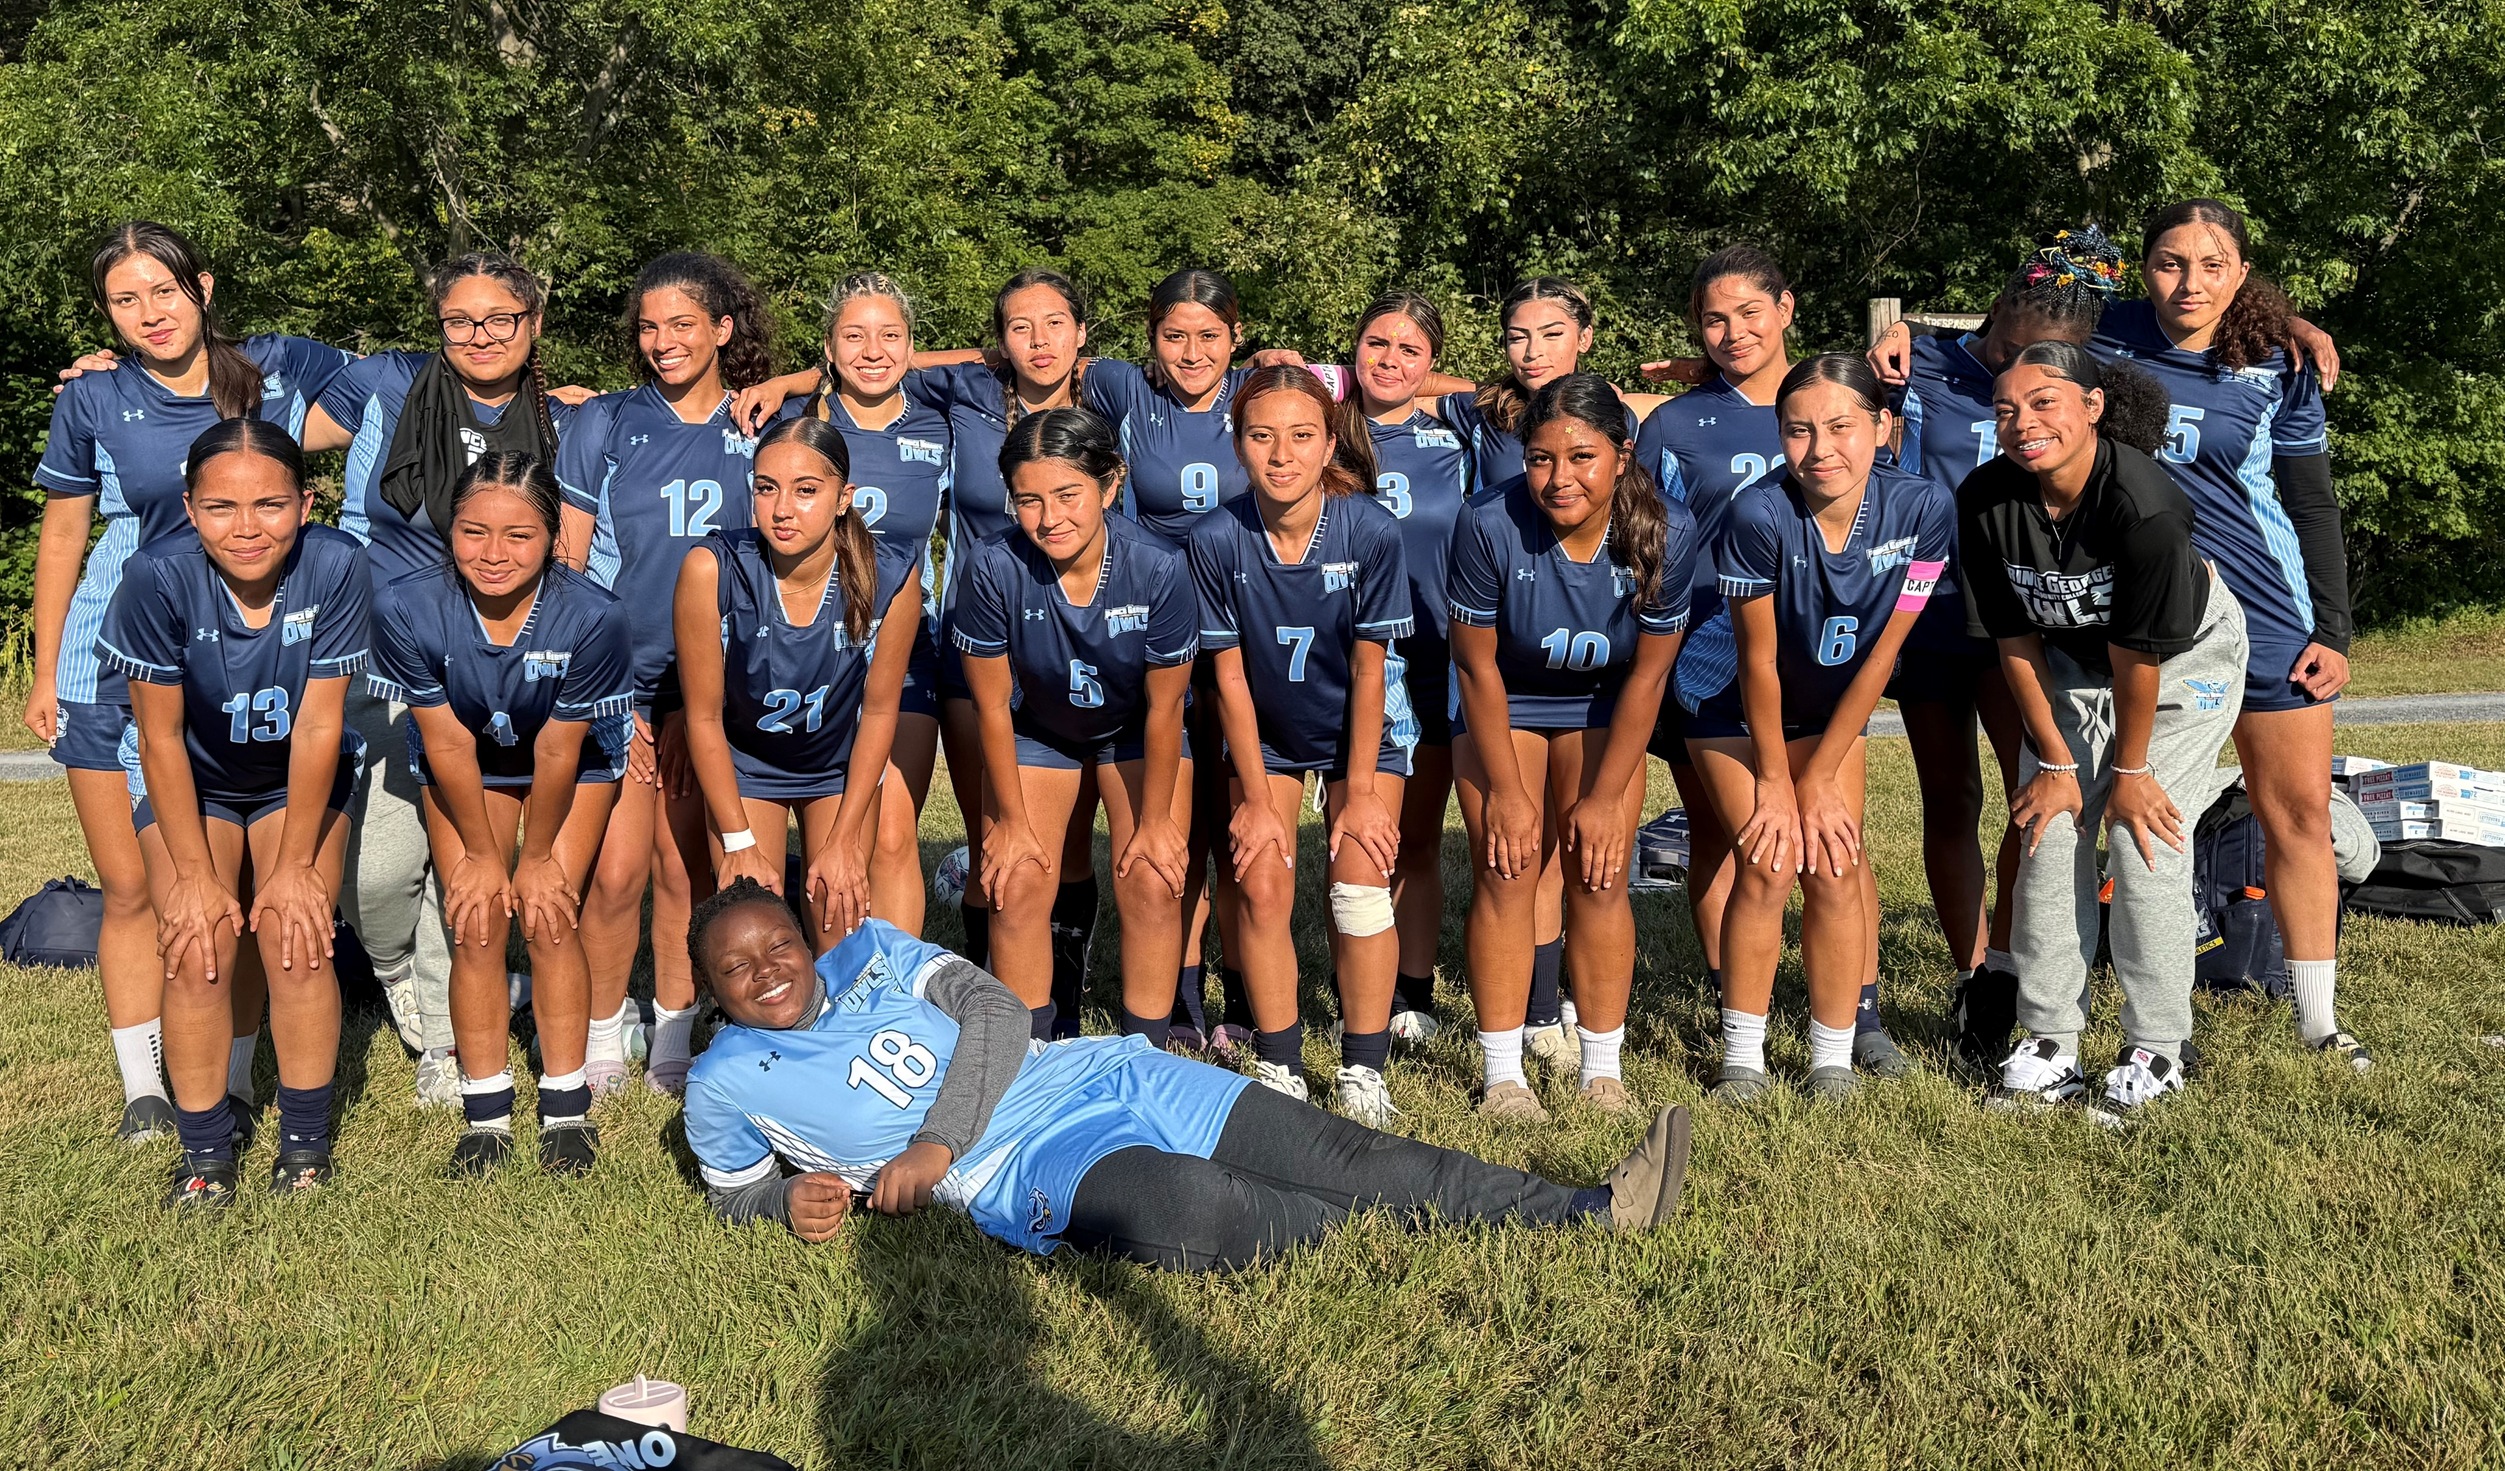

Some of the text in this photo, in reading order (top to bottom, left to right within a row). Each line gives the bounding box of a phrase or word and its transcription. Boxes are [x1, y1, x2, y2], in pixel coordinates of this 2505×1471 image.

[899, 444, 944, 467] OWLS
[1415, 433, 1461, 450] OWLS
[1971, 420, 2005, 467] 1
[2154, 404, 2205, 464] 5
[1181, 462, 1218, 513] 9
[1376, 471, 1412, 520] 3
[1730, 452, 1787, 501] 2
[660, 479, 723, 537] 12
[852, 486, 888, 534] 2
[2046, 562, 2115, 594] GEORGE
[282, 621, 312, 646] OW
[1276, 626, 1315, 681] 7
[1541, 628, 1610, 671] 10
[1818, 616, 1859, 666] 6
[1069, 659, 1105, 708] 5
[222, 685, 290, 743] 13
[482, 711, 519, 747] 4
[756, 684, 830, 734] 21
[840, 959, 893, 1013] OWLS
[846, 1029, 938, 1111] 18
[582, 1431, 677, 1470] ONE
